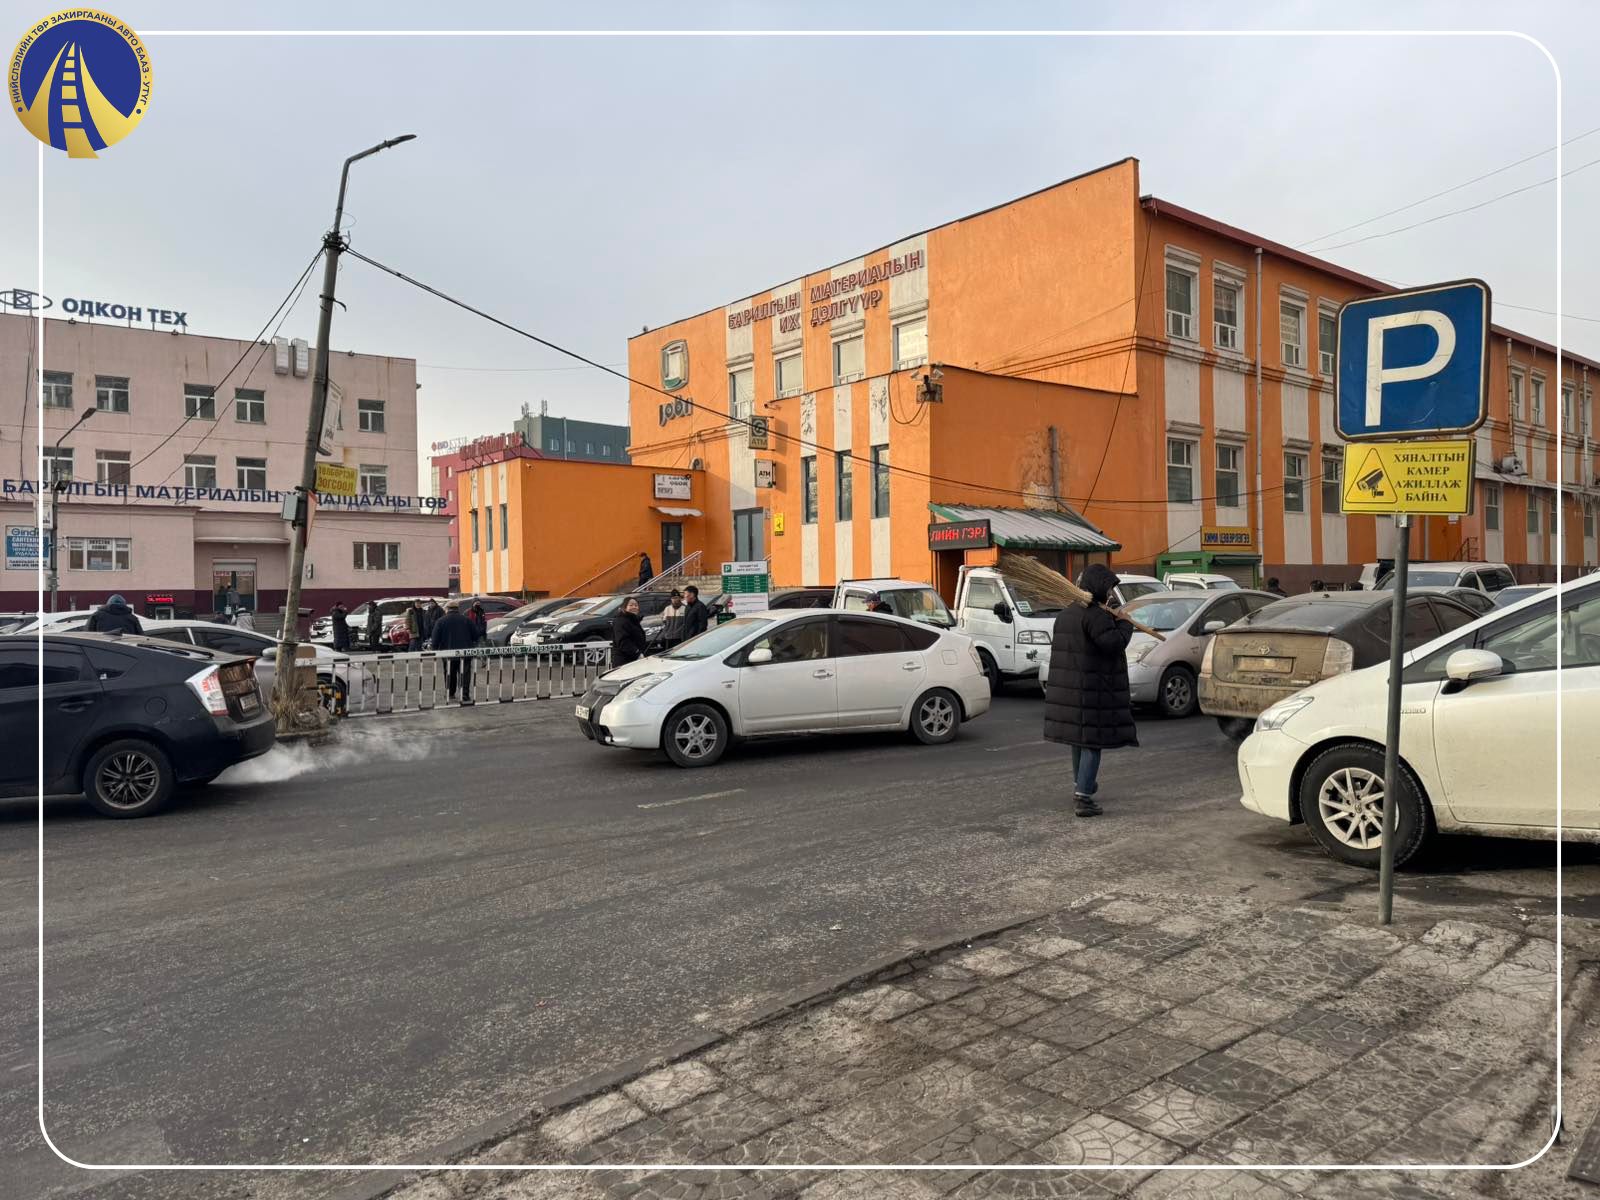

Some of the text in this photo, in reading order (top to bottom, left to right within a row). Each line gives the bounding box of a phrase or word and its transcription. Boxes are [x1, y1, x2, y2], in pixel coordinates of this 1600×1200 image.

[728, 249, 924, 330] БАРИЛГЫН МАТЕРИАЛЫН
[62, 298, 188, 326] ОДКОН ТЕХ
[779, 289, 883, 333] ИХ ДЭЛГҮҮР
[1364, 309, 1457, 427] P
[751, 437, 768, 446] ATM
[1393, 452, 1466, 463] ХЯНАЛТЫН
[1406, 467, 1450, 476] КАМЕР
[318, 477, 355, 493] ЗОГСООЛ
[1394, 479, 1462, 489] АЖИЛЛАЖ
[136, 484, 279, 503] МАТЕРИАЛЫН
[417, 496, 447, 509] ТӨВ
[1405, 490, 1448, 502] БАЙНА
[466, 649, 487, 657] MOST
[490, 647, 522, 656] PARKING
